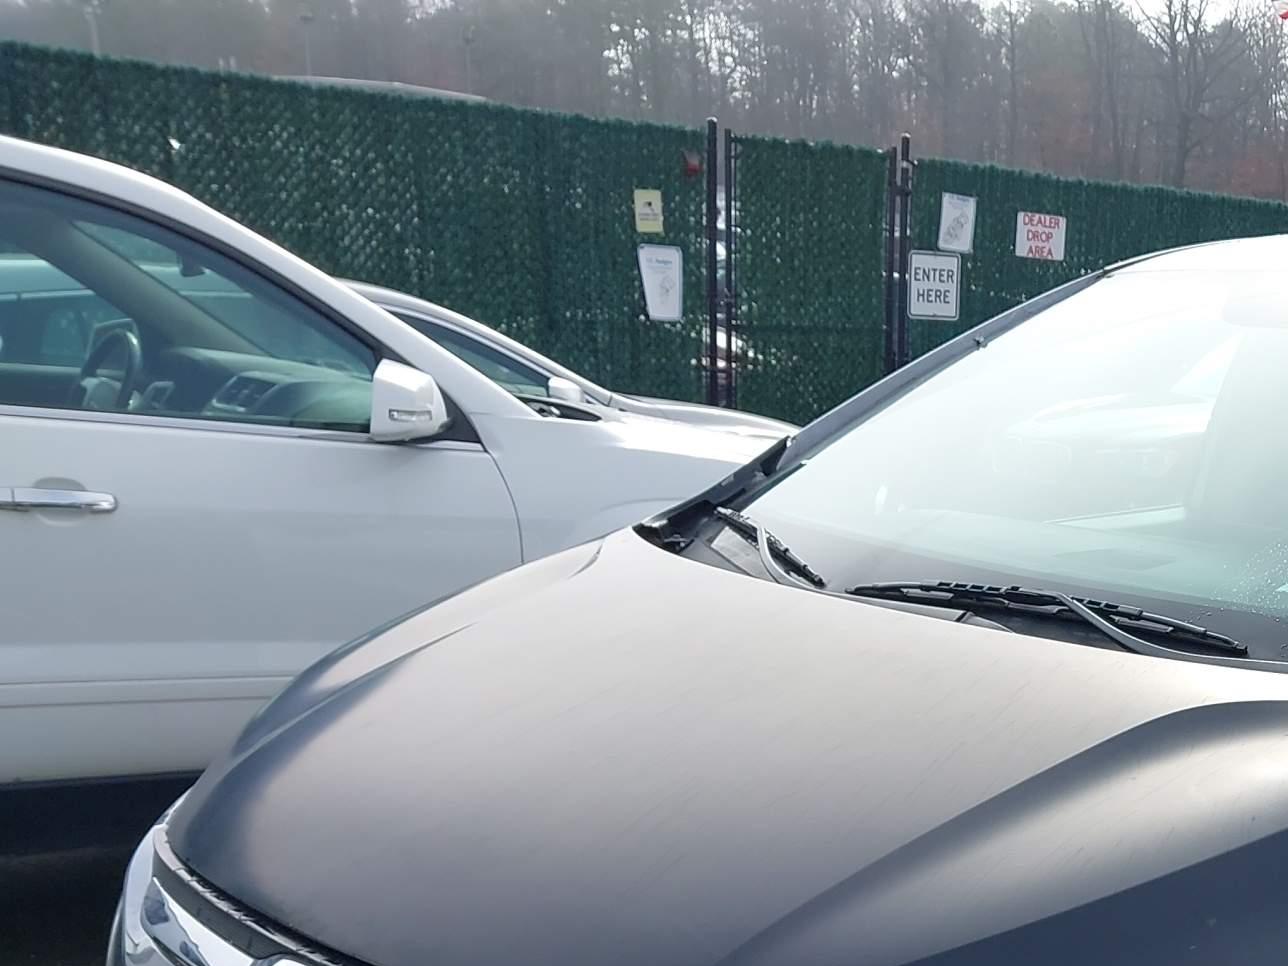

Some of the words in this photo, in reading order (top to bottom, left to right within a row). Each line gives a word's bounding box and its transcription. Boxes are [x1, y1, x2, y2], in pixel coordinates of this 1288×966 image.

[1023, 213, 1060, 229] DEALER
[1026, 229, 1053, 243] DROP
[1026, 245, 1054, 258] AREA
[914, 266, 954, 283] ENTER
[917, 288, 950, 304] HERE
